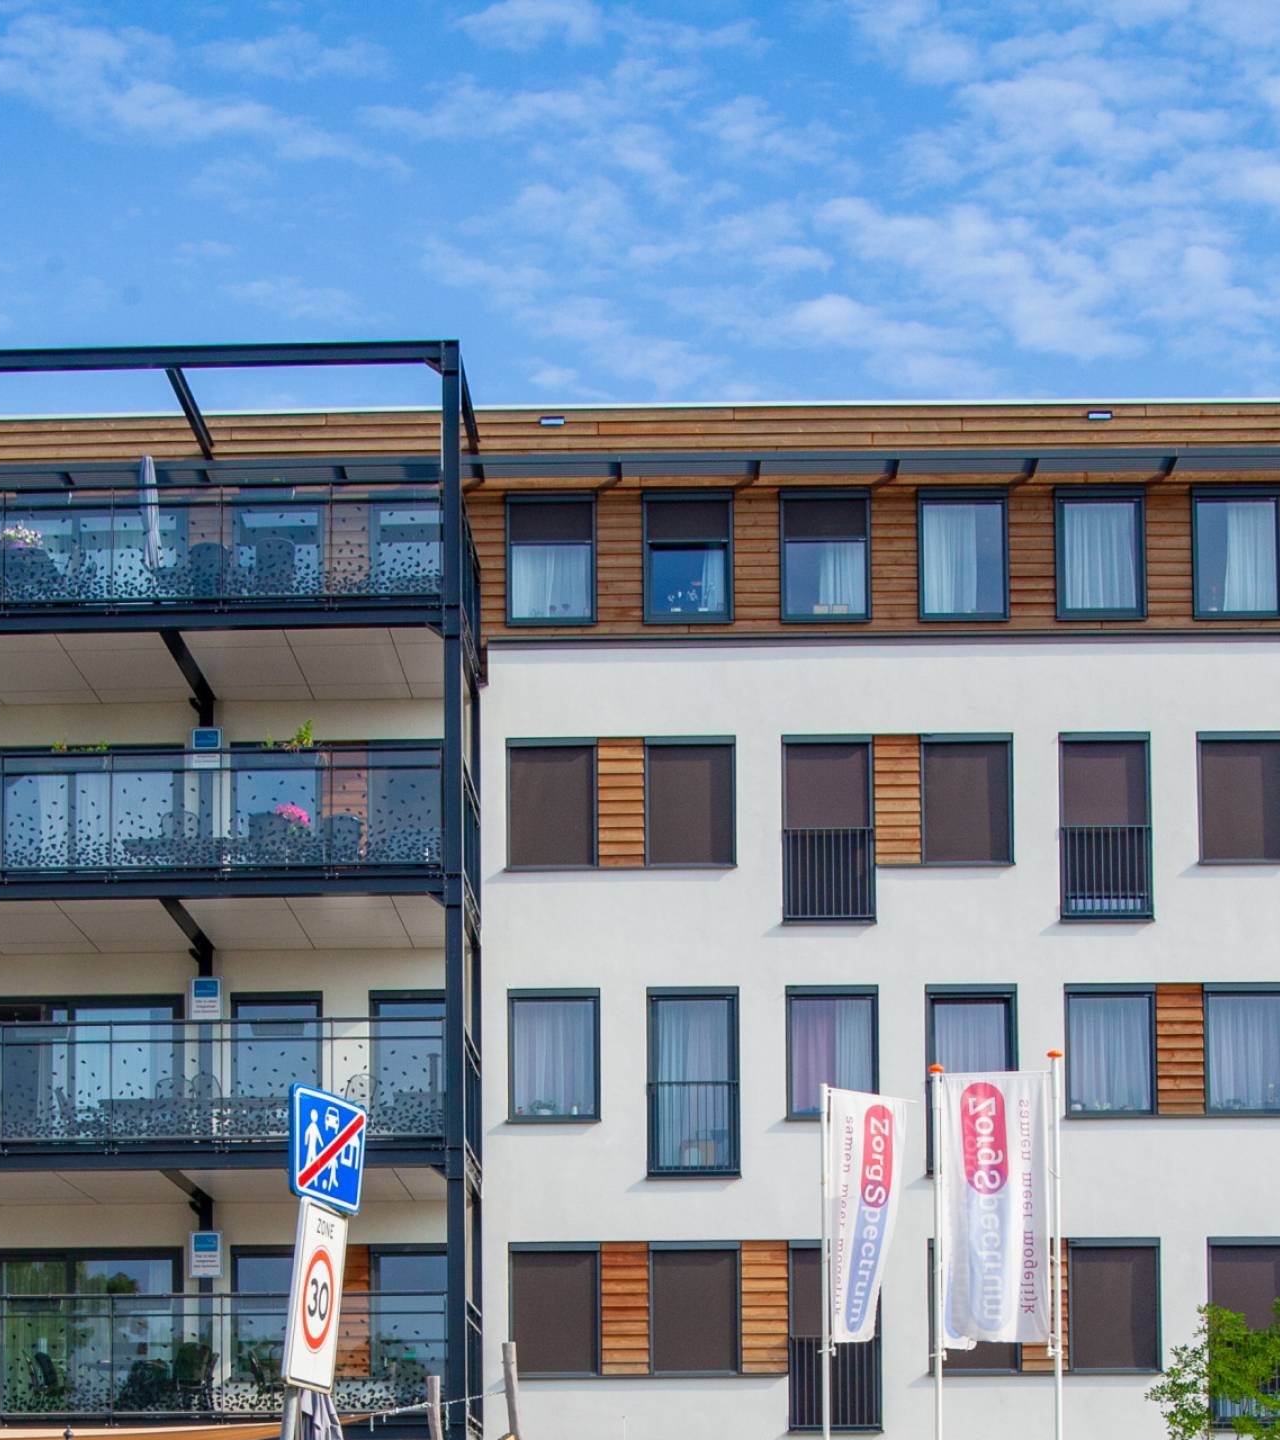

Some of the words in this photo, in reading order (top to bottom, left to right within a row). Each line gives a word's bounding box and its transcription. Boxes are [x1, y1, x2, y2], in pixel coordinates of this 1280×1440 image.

[842, 1116, 854, 1173] samen
[317, 1218, 335, 1239] ZONE
[849, 1116, 889, 1324] ZorgSpectrum
[308, 1278, 329, 1321] 30
